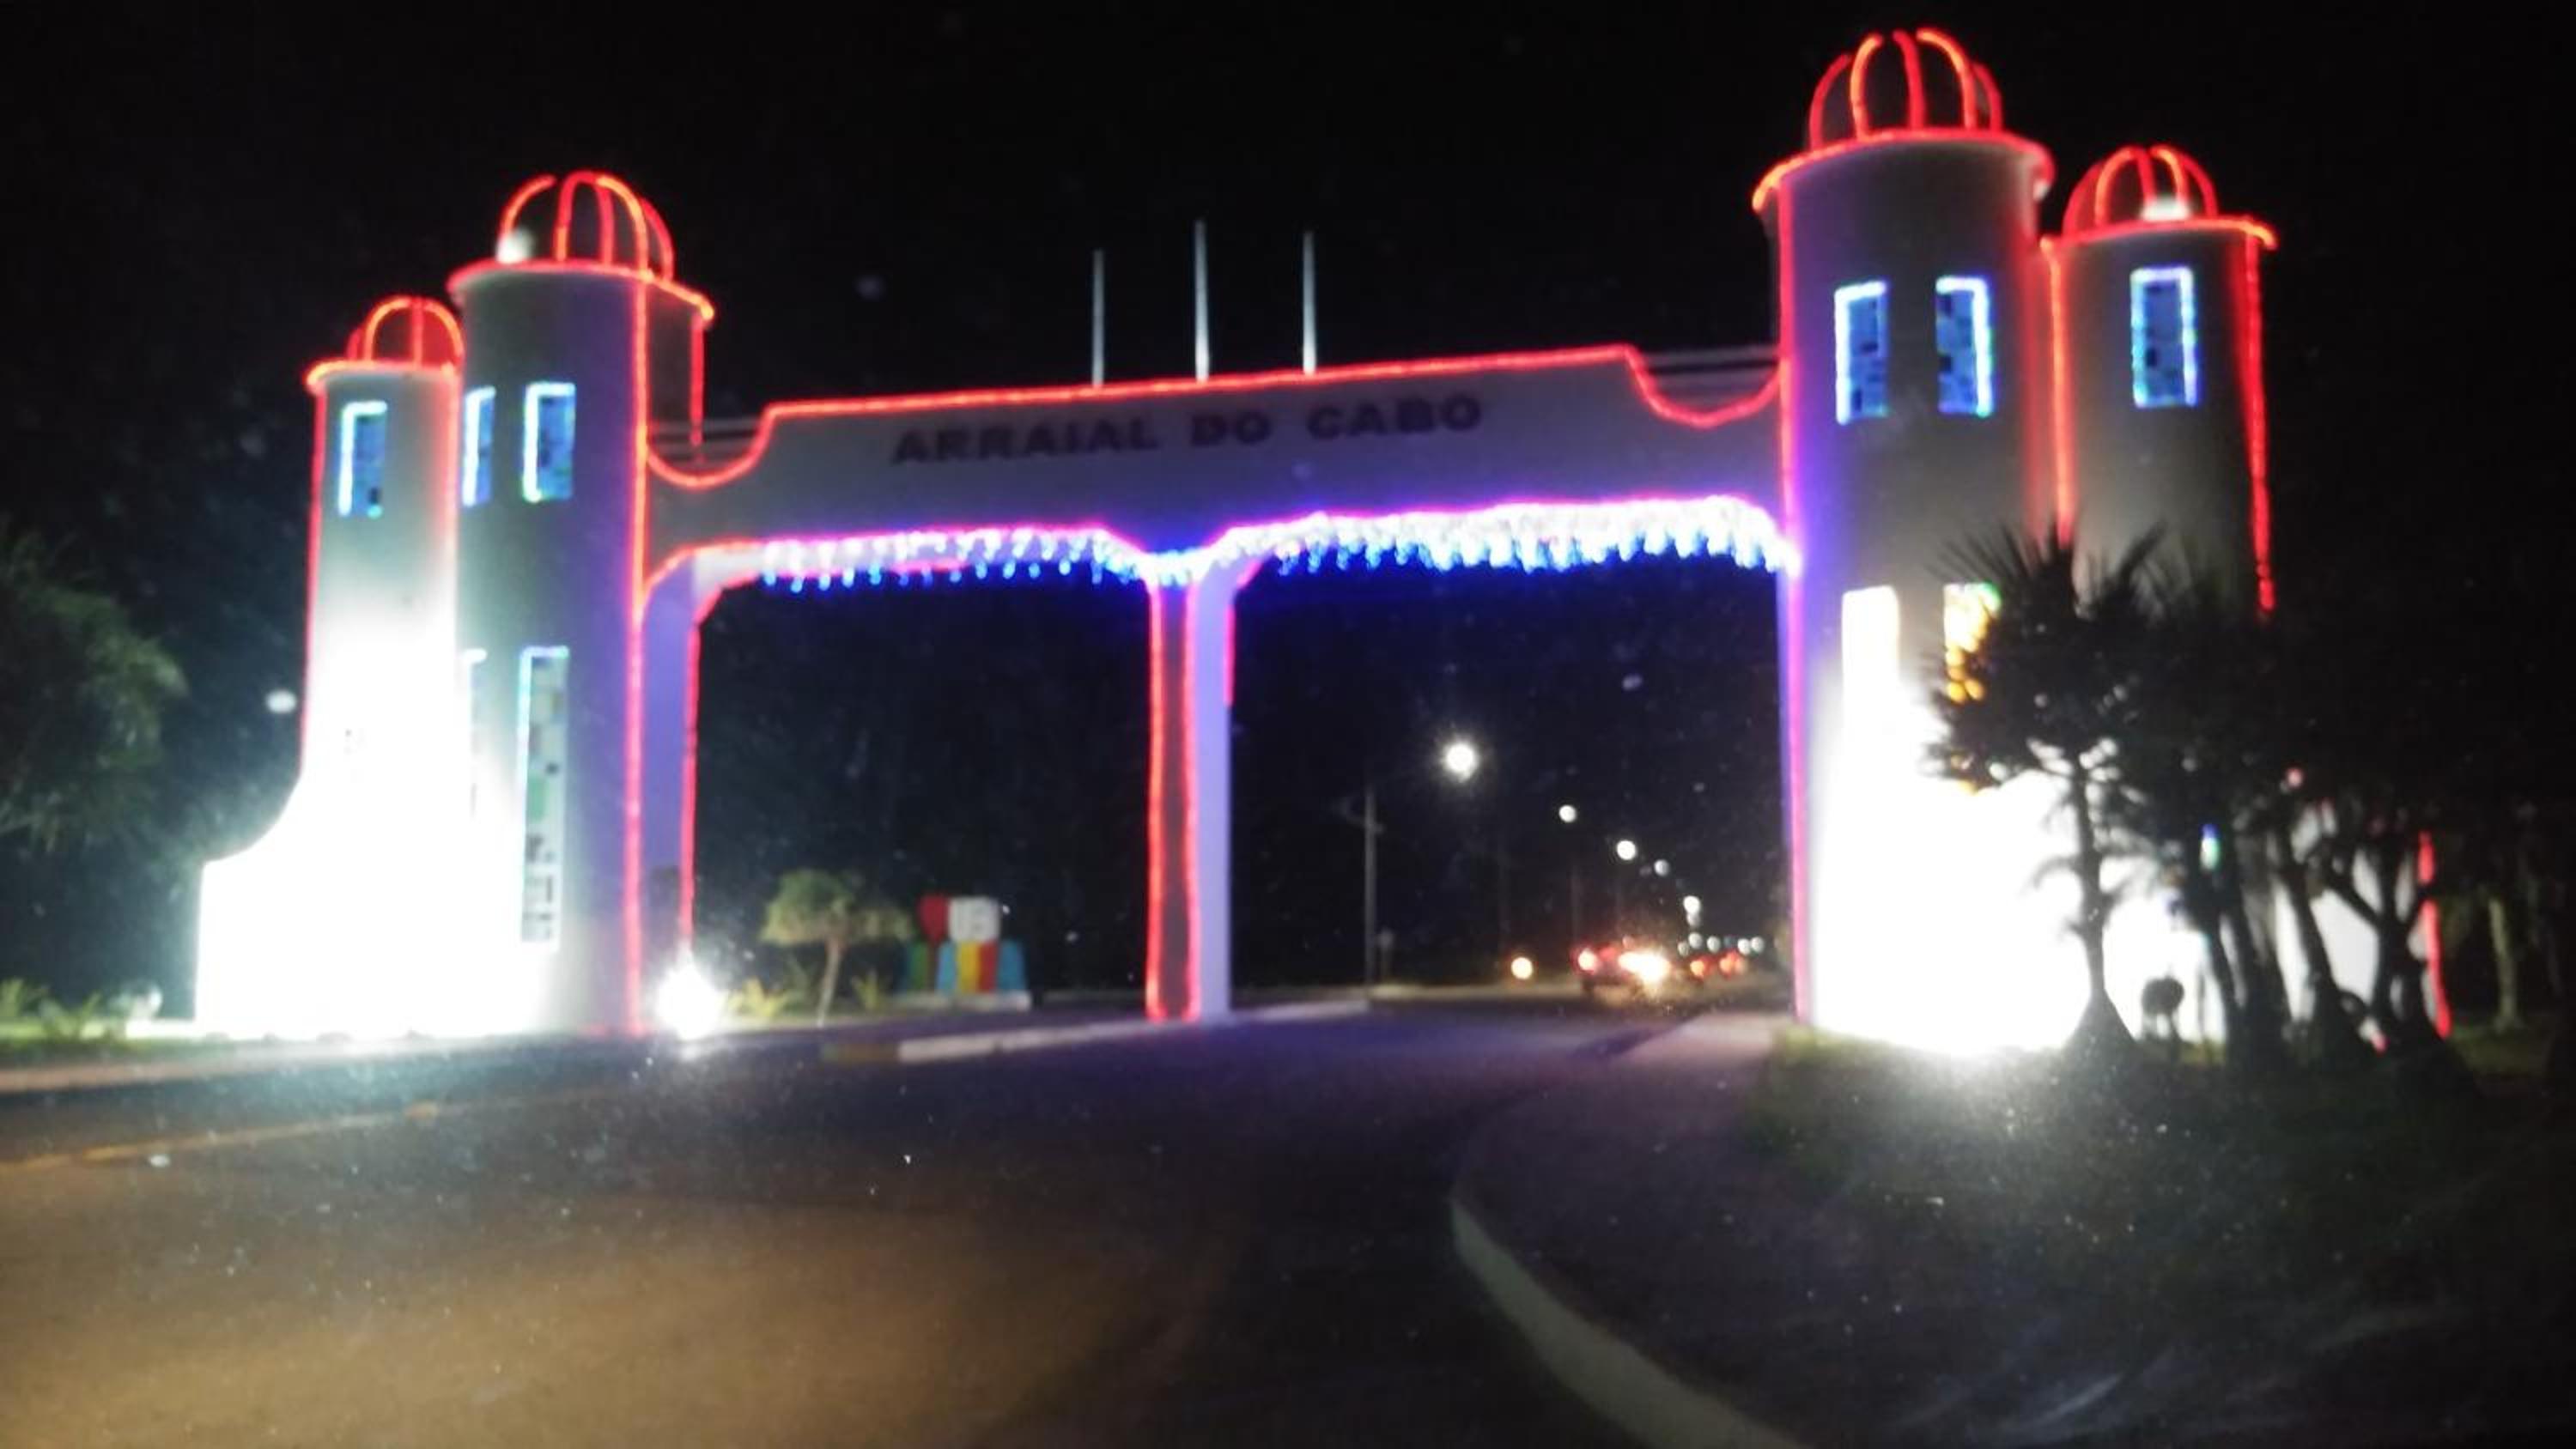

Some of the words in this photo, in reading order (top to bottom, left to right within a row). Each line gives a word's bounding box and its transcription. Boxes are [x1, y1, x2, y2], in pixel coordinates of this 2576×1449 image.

[893, 418, 1159, 464] ARRAIAL
[1191, 412, 1272, 446] DO
[1307, 394, 1482, 440] CABO
